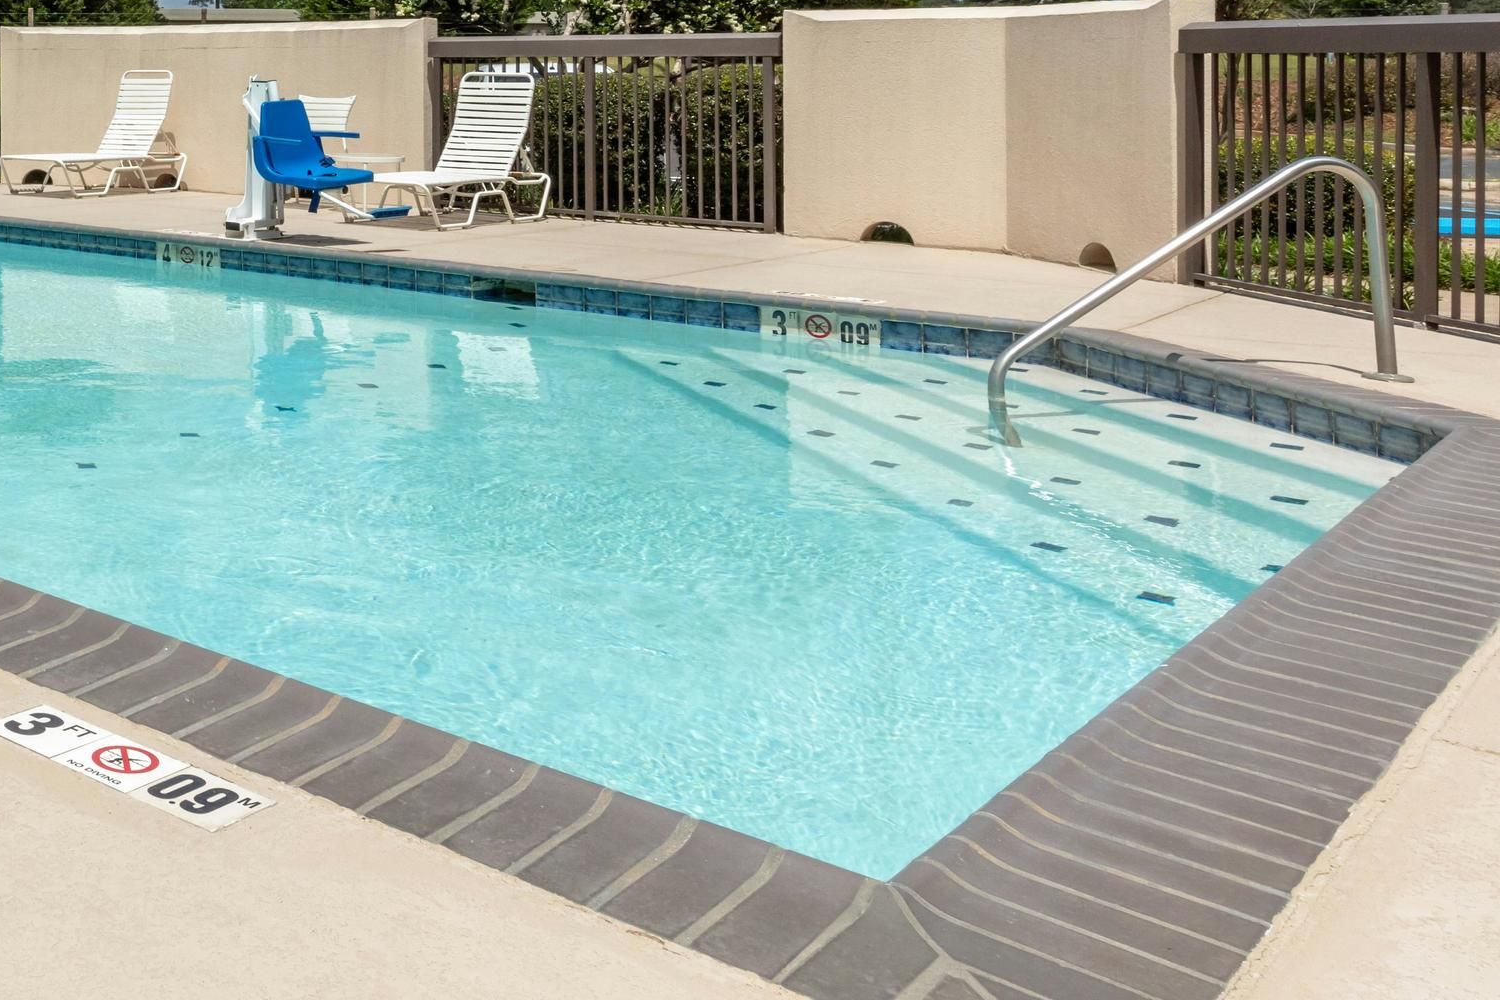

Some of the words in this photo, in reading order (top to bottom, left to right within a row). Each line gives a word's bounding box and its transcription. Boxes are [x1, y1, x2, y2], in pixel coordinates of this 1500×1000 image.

[162, 243, 171, 263] 4
[772, 310, 787, 336] 3
[789, 311, 797, 320] FT
[869, 323, 877, 331] M
[3, 712, 65, 736] 3
[62, 724, 98, 739] FT
[66, 759, 84, 768] NO
[84, 767, 122, 785] DIVING
[147, 774, 240, 815] 0.9
[237, 797, 262, 809] M
